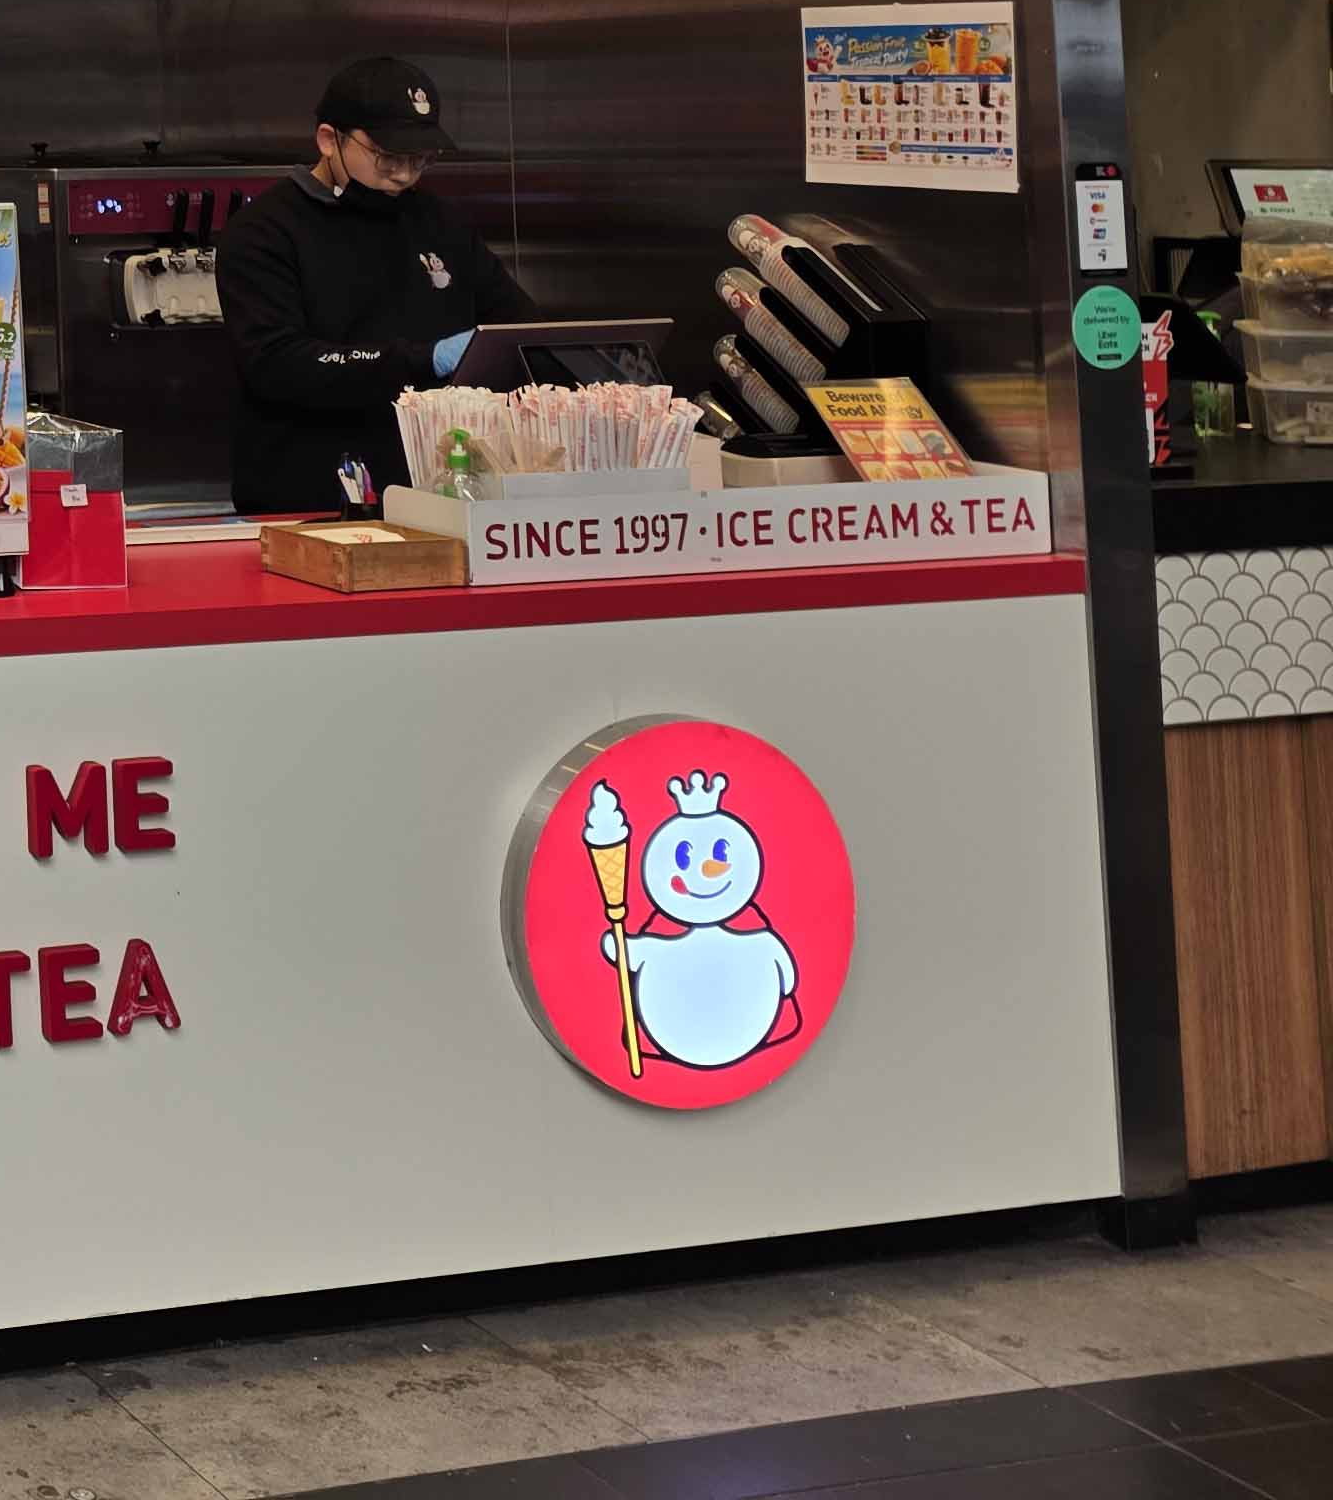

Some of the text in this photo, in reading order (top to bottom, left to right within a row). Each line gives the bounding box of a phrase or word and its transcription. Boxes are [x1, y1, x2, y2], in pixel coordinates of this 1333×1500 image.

[826, 390, 886, 404] Beware
[827, 404, 867, 417] Food
[485, 497, 1036, 560] SINCE 1997 ICE CREAM & TEA
[25, 756, 176, 859] ME
